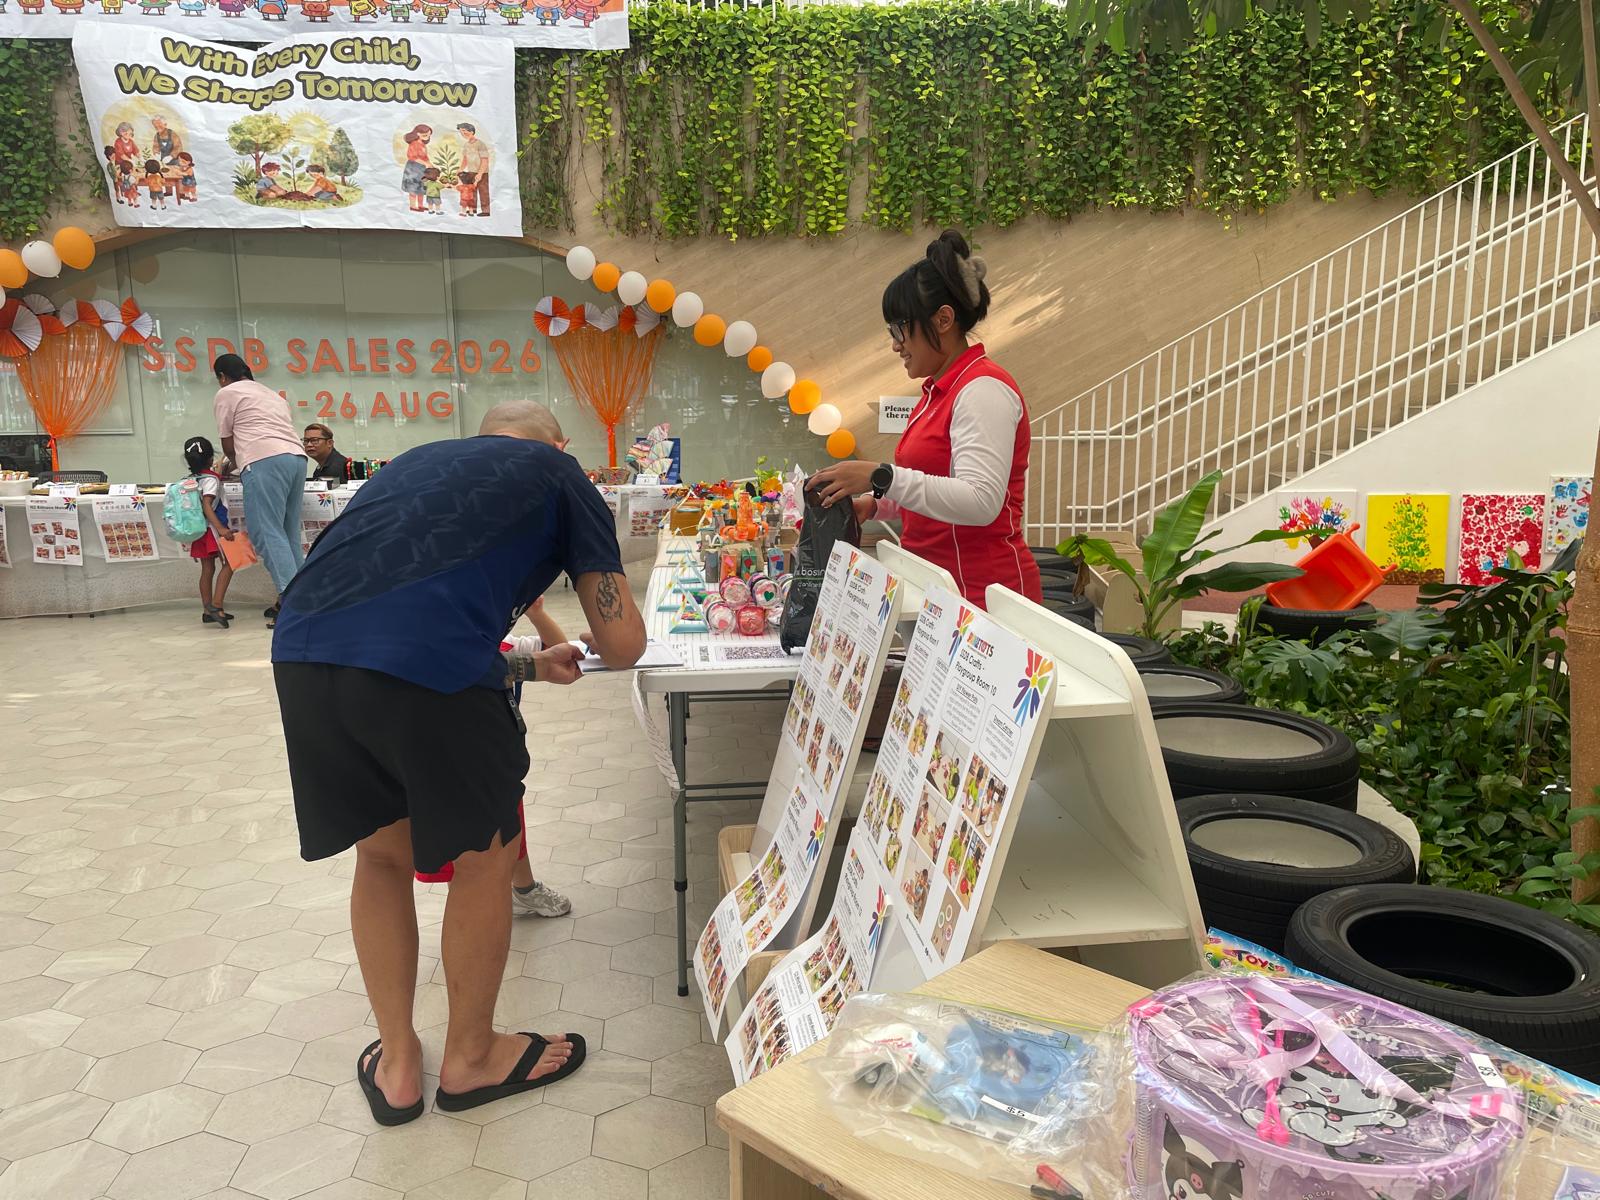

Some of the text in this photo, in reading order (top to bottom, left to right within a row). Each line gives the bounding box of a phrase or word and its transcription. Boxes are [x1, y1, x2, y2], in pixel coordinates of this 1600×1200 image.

[160, 37, 421, 78] With Every Child,
[114, 63, 477, 111] We Shape Tomorrow
[143, 335, 541, 374] SSDB SALES 2026
[370, 391, 454, 418] AUG
[801, 566, 826, 576] bosin
[955, 662, 976, 682] Playgroup
[975, 676, 990, 691] Room
[1006, 1105, 1026, 1118] $5
